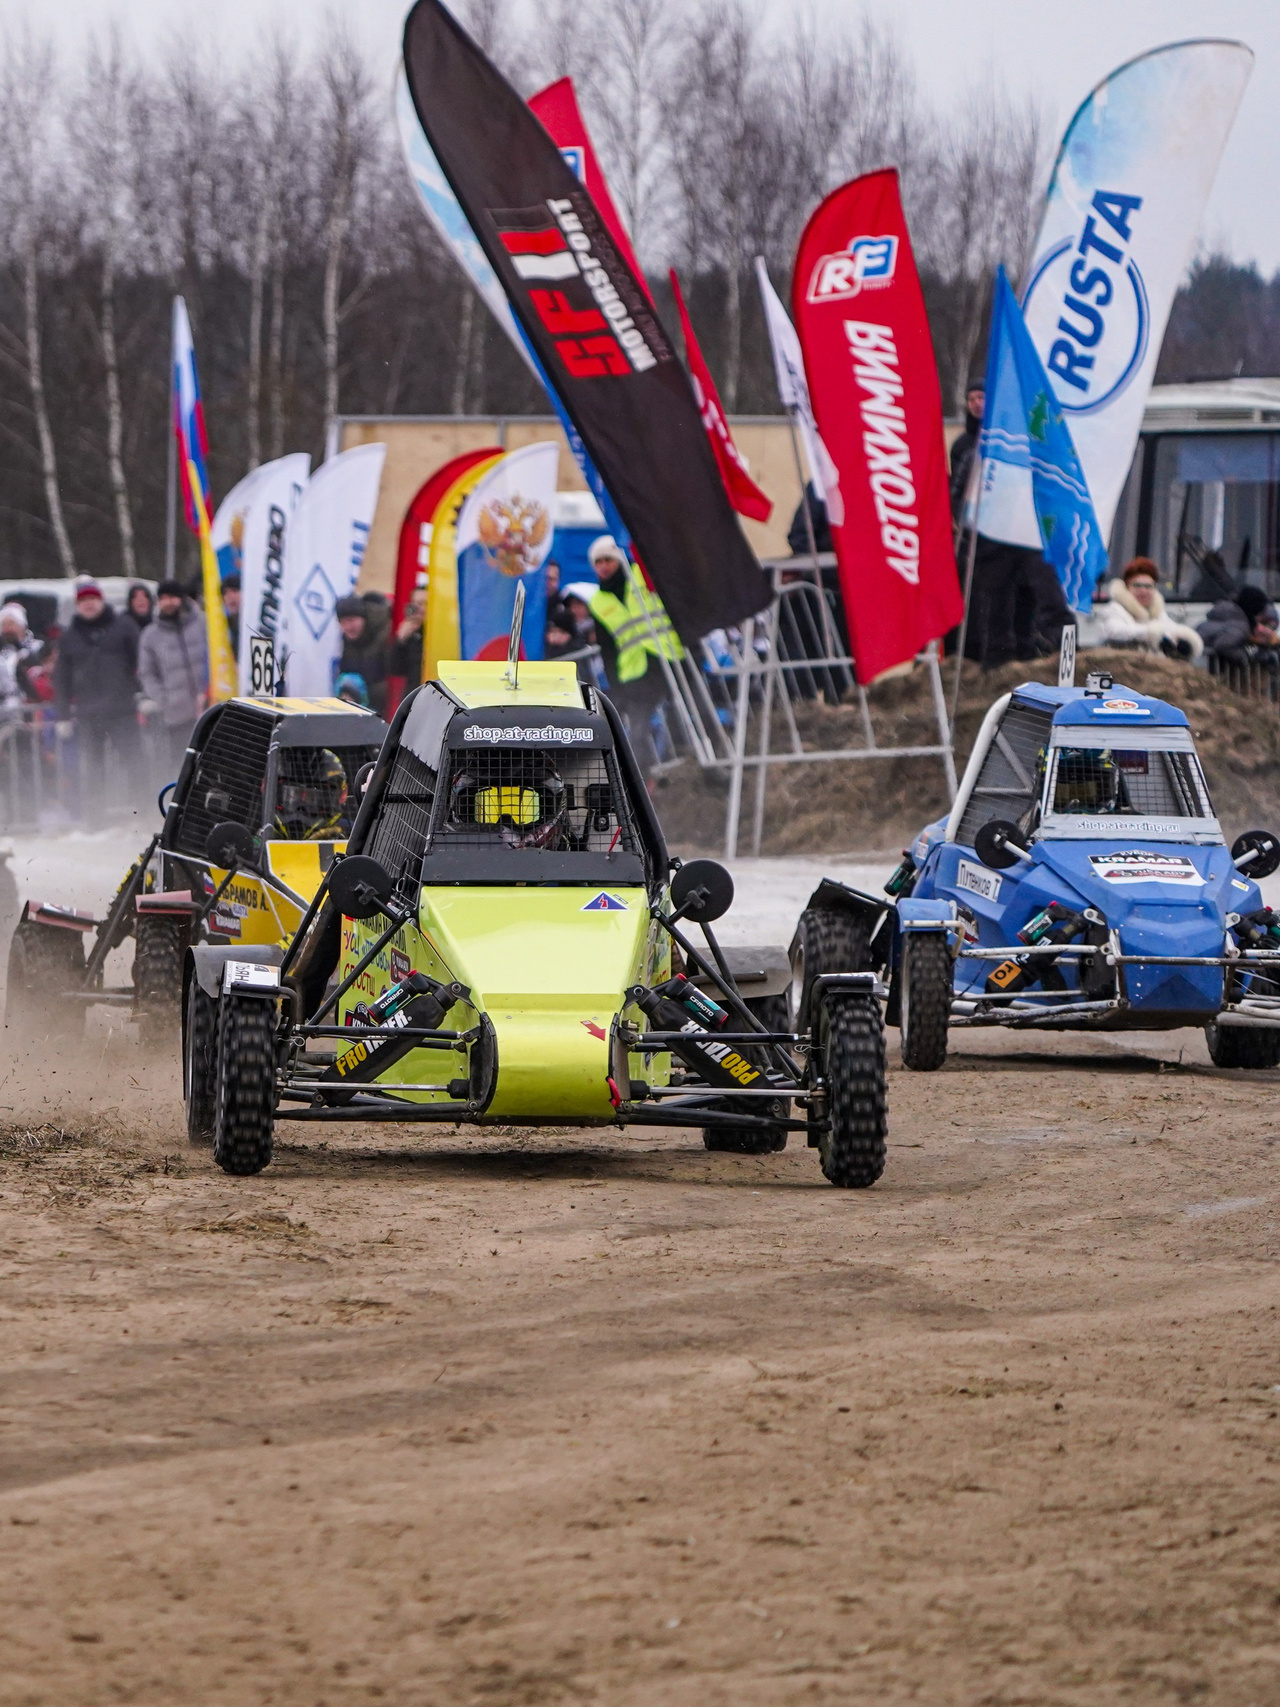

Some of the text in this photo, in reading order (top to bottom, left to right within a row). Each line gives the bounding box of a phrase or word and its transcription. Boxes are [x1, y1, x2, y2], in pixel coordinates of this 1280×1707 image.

[546, 198, 659, 374] MOTORSPORT
[1047, 188, 1143, 395] RUSTA
[843, 319, 920, 586] АВТОХИМИЯ
[252, 648, 273, 692] 66
[1061, 631, 1074, 680] 89
[464, 725, 593, 743] shop.at-racing.ru
[1097, 857, 1183, 865] KRAMAR
[220, 883, 258, 909] БРАМОВ
[689, 995, 714, 1018] CFMOTO
